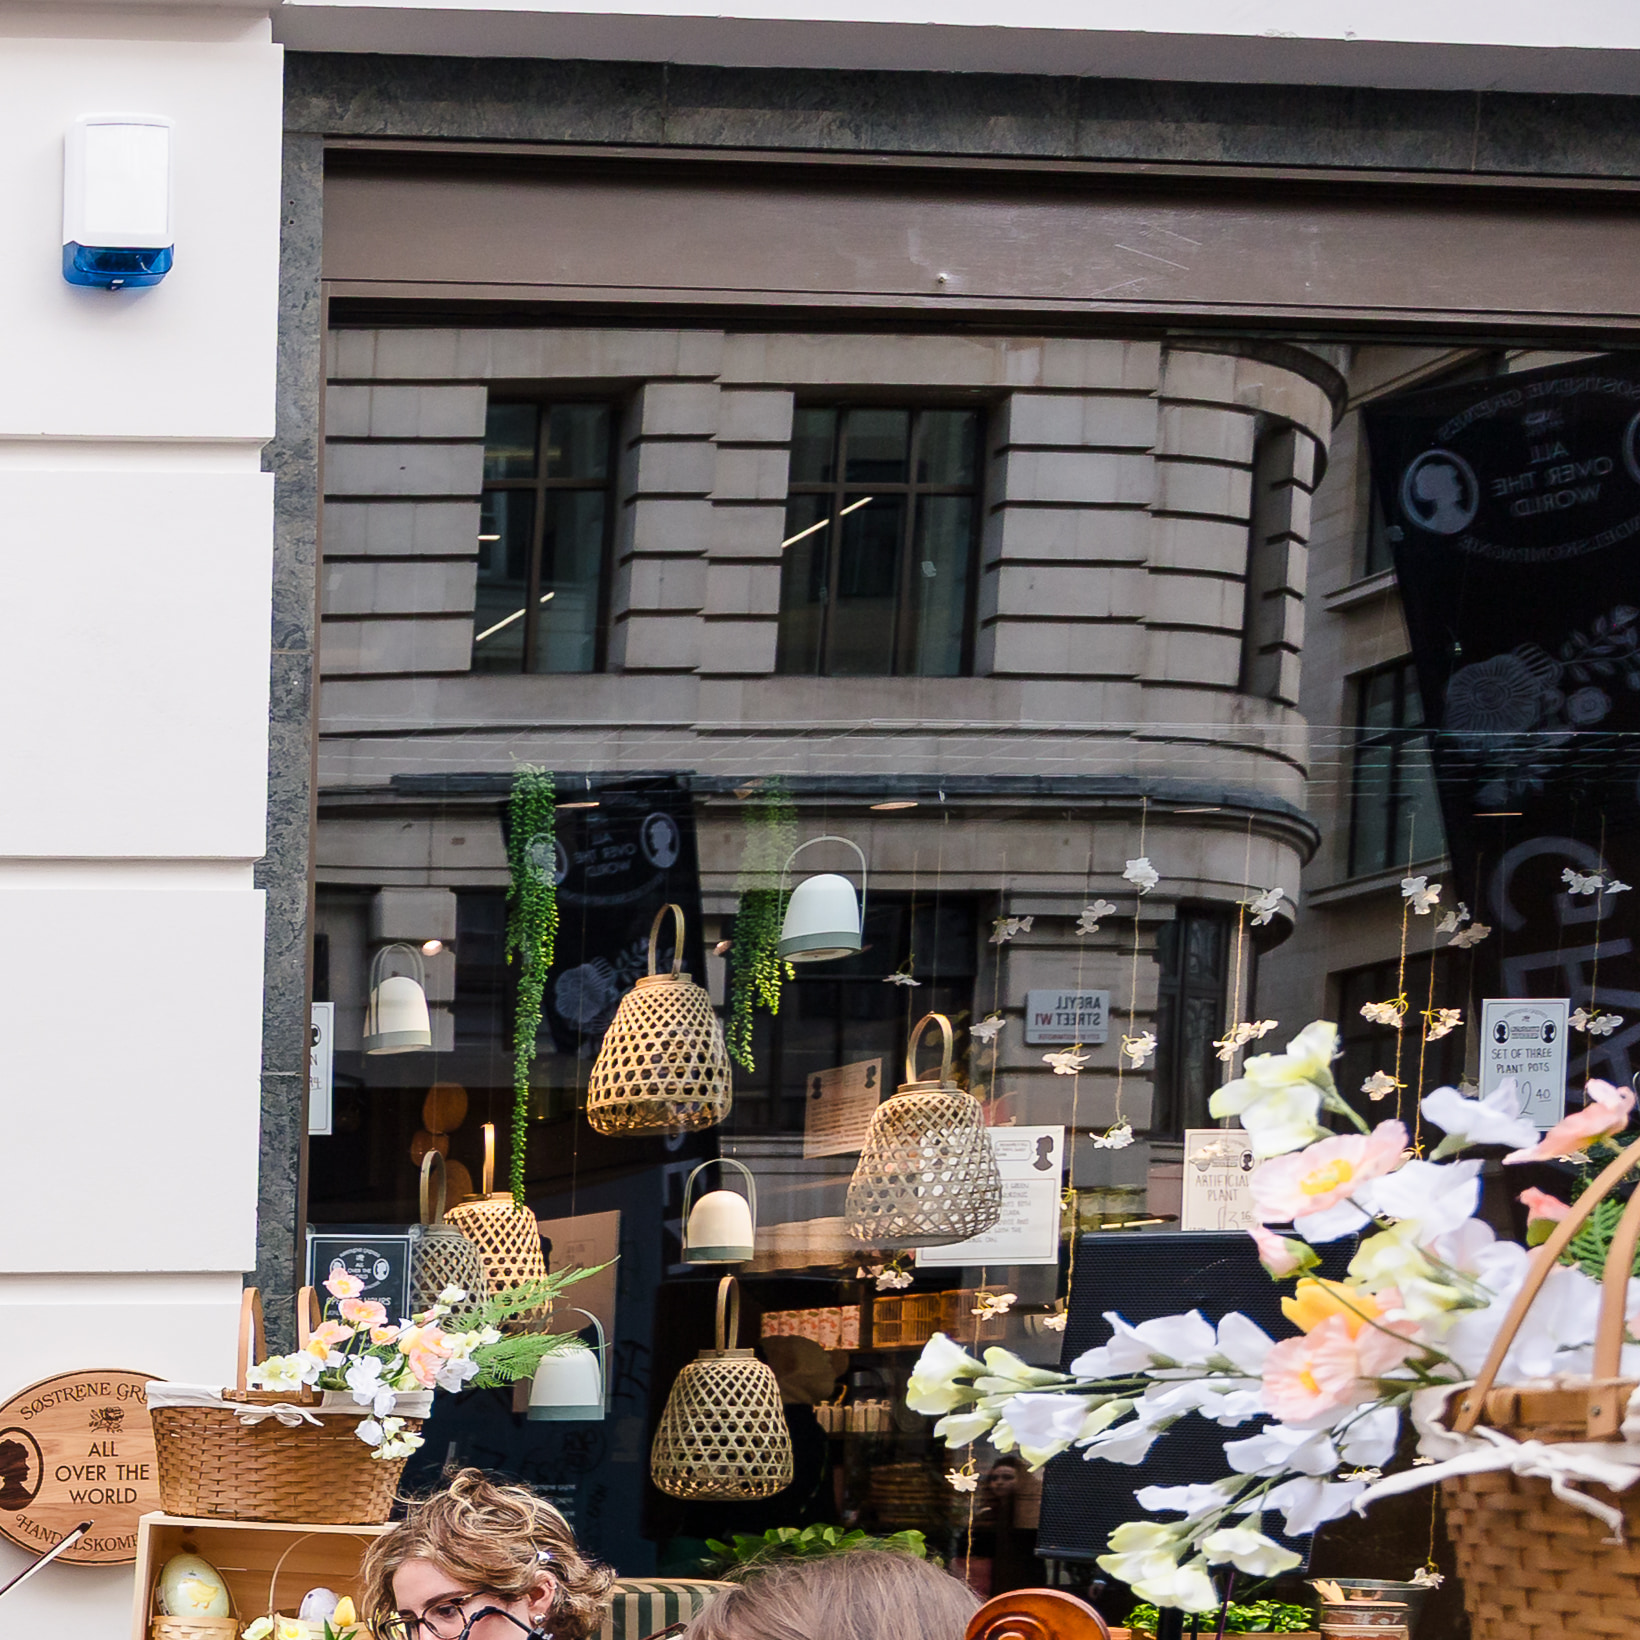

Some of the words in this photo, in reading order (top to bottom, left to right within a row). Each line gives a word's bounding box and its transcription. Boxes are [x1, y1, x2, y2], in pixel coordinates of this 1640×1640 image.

[1491, 1048, 1508, 1060] SET
[1510, 1047, 1522, 1060] OF
[1525, 1047, 1553, 1059] THREE
[1496, 1063, 1524, 1074] PLANT
[1527, 1062, 1551, 1073] POTS
[1195, 1174, 1250, 1188] ARTIFICIAL
[1207, 1188, 1239, 1202] PLANT
[20, 1382, 112, 1421] SØSTRENE
[87, 1440, 119, 1458] ALL
[55, 1464, 107, 1482] OVER
[115, 1464, 150, 1481] THE
[69, 1487, 138, 1505] WORLD
